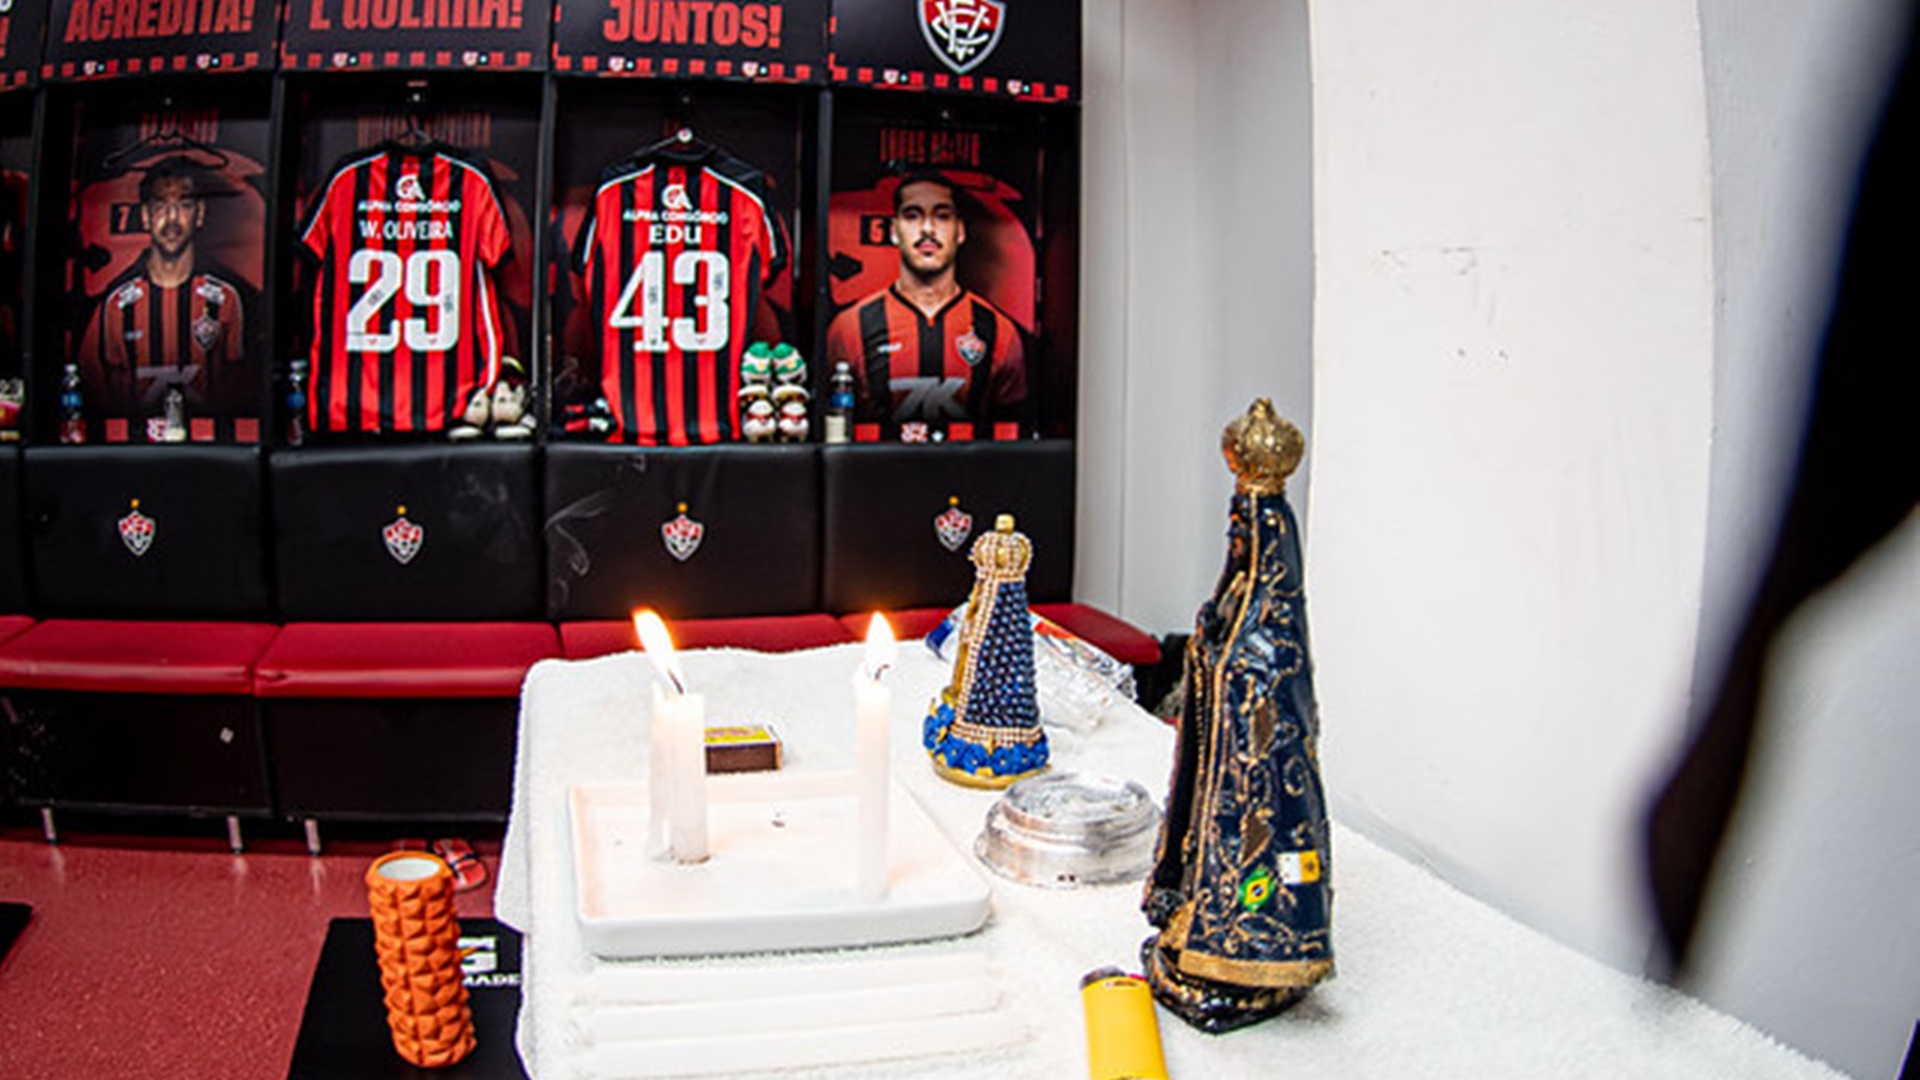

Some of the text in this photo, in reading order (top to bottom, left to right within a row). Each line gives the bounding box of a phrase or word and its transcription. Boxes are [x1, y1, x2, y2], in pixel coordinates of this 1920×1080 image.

[64, 0, 255, 42] ACREDITA!
[603, 0, 783, 48] JUNTOS!
[358, 220, 381, 239] W.
[649, 225, 702, 244] EDU
[346, 248, 461, 352] 29
[609, 250, 731, 352] 43
